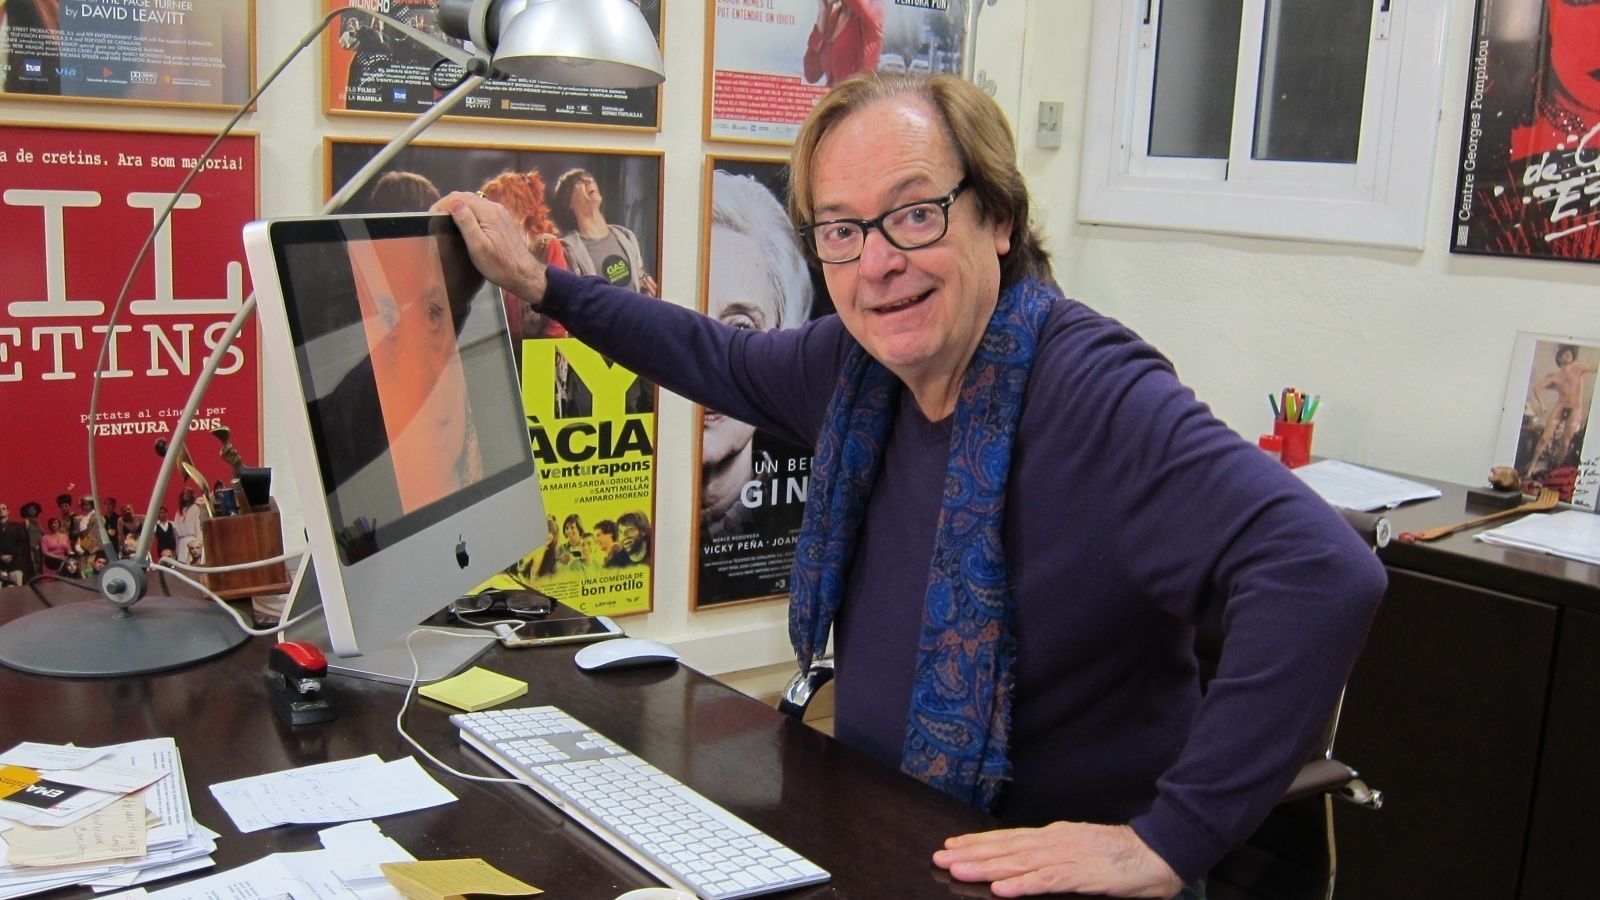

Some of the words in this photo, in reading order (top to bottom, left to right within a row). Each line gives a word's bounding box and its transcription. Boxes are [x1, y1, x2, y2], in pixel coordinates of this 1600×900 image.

[65, 6, 78, 18] by
[81, 4, 128, 20] DAVID
[132, 8, 186, 25] LEAVITT
[1470, 39, 1489, 110] Pompidou
[1463, 113, 1483, 171] Georges
[16, 149, 34, 164] de
[42, 150, 109, 166] cretins.
[118, 153, 143, 167] Ara
[150, 155, 176, 169] som
[1523, 151, 1563, 186] de
[1458, 189, 1475, 221] Centre
[606, 260, 626, 275] GAS
[138, 409, 152, 418] al
[206, 407, 227, 417] per
[86, 420, 170, 437] VENTURA
[177, 418, 222, 432] ONS
[541, 460, 651, 480] venturapons
[754, 460, 779, 475] UN
[550, 481, 577, 491] MARIA
[614, 491, 650, 500] MORENO
[740, 476, 808, 509] GIN
[703, 543, 734, 555] VICKY
[737, 540, 764, 551] PEÑA
[772, 536, 798, 547] JOAN
[581, 586, 605, 597] bon
[609, 579, 644, 593] rotllo
[25, 784, 65, 798] EMA
